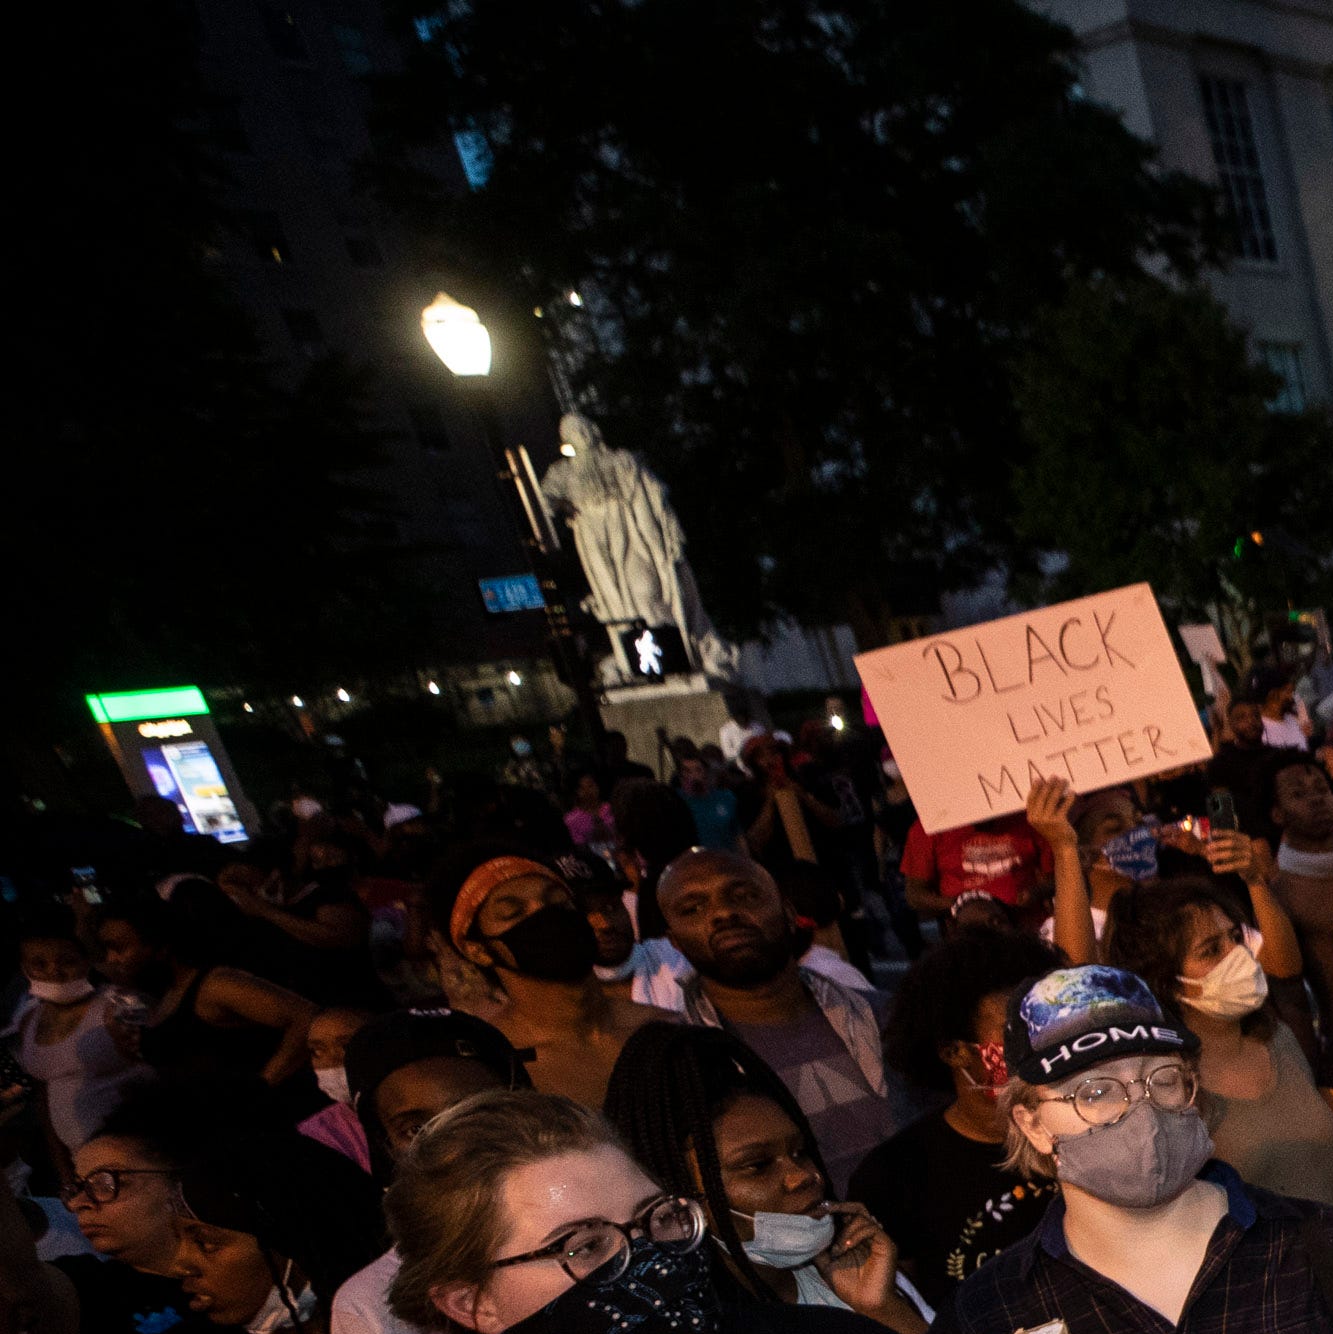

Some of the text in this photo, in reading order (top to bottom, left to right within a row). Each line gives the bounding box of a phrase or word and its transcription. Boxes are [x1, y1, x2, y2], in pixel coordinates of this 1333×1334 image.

[923, 611, 1135, 705] BLACK
[1007, 686, 1114, 744] LIVES
[977, 725, 1177, 809] MATTER
[1040, 1024, 1184, 1074] HOME
